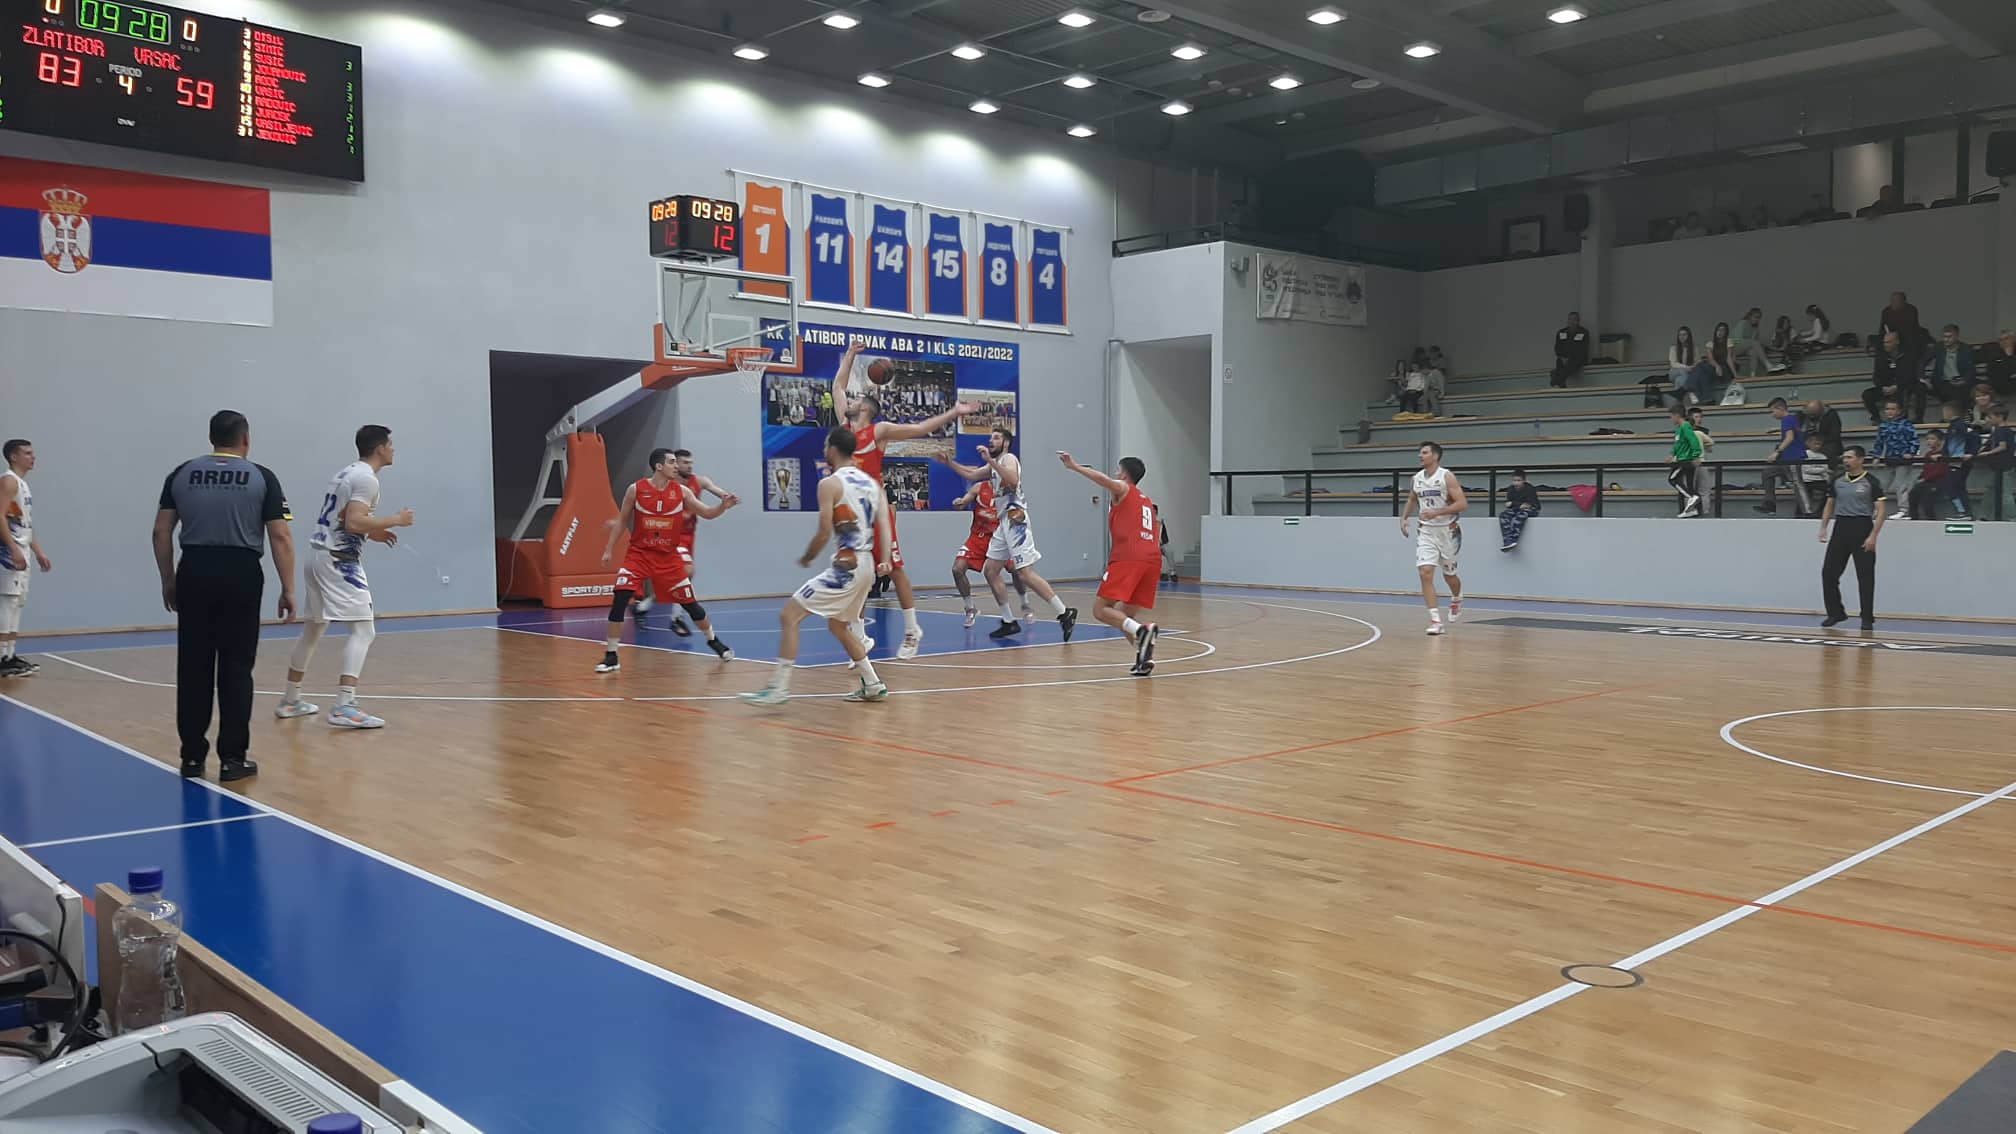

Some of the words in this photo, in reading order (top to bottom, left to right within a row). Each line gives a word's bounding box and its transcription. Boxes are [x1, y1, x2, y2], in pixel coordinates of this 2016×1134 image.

[22, 25, 105, 57] ZLATIBOR
[183, 20, 197, 42] 0
[39, 53, 81, 87] 83
[108, 63, 143, 78] PERIOD
[134, 46, 182, 71] VRSAC
[119, 75, 133, 95] 4
[177, 77, 214, 110] 59
[714, 225, 735, 251] 12
[755, 223, 771, 254] 1
[815, 232, 844, 265] 11
[874, 241, 904, 274] 14
[932, 248, 960, 279] 15
[990, 257, 1008, 287] 8
[1038, 263, 1055, 290] 4
[789, 327, 845, 346] ATIBOR
[848, 333, 887, 350] PRVAK
[891, 337, 914, 353] ABA
[917, 340, 925, 353] 2
[934, 341, 955, 357] KLS
[958, 344, 1014, 361] 2021/2022
[189, 470, 250, 485] ARDU
[1142, 504, 1153, 531] 9
[561, 585, 616, 595] SPORTSYST
